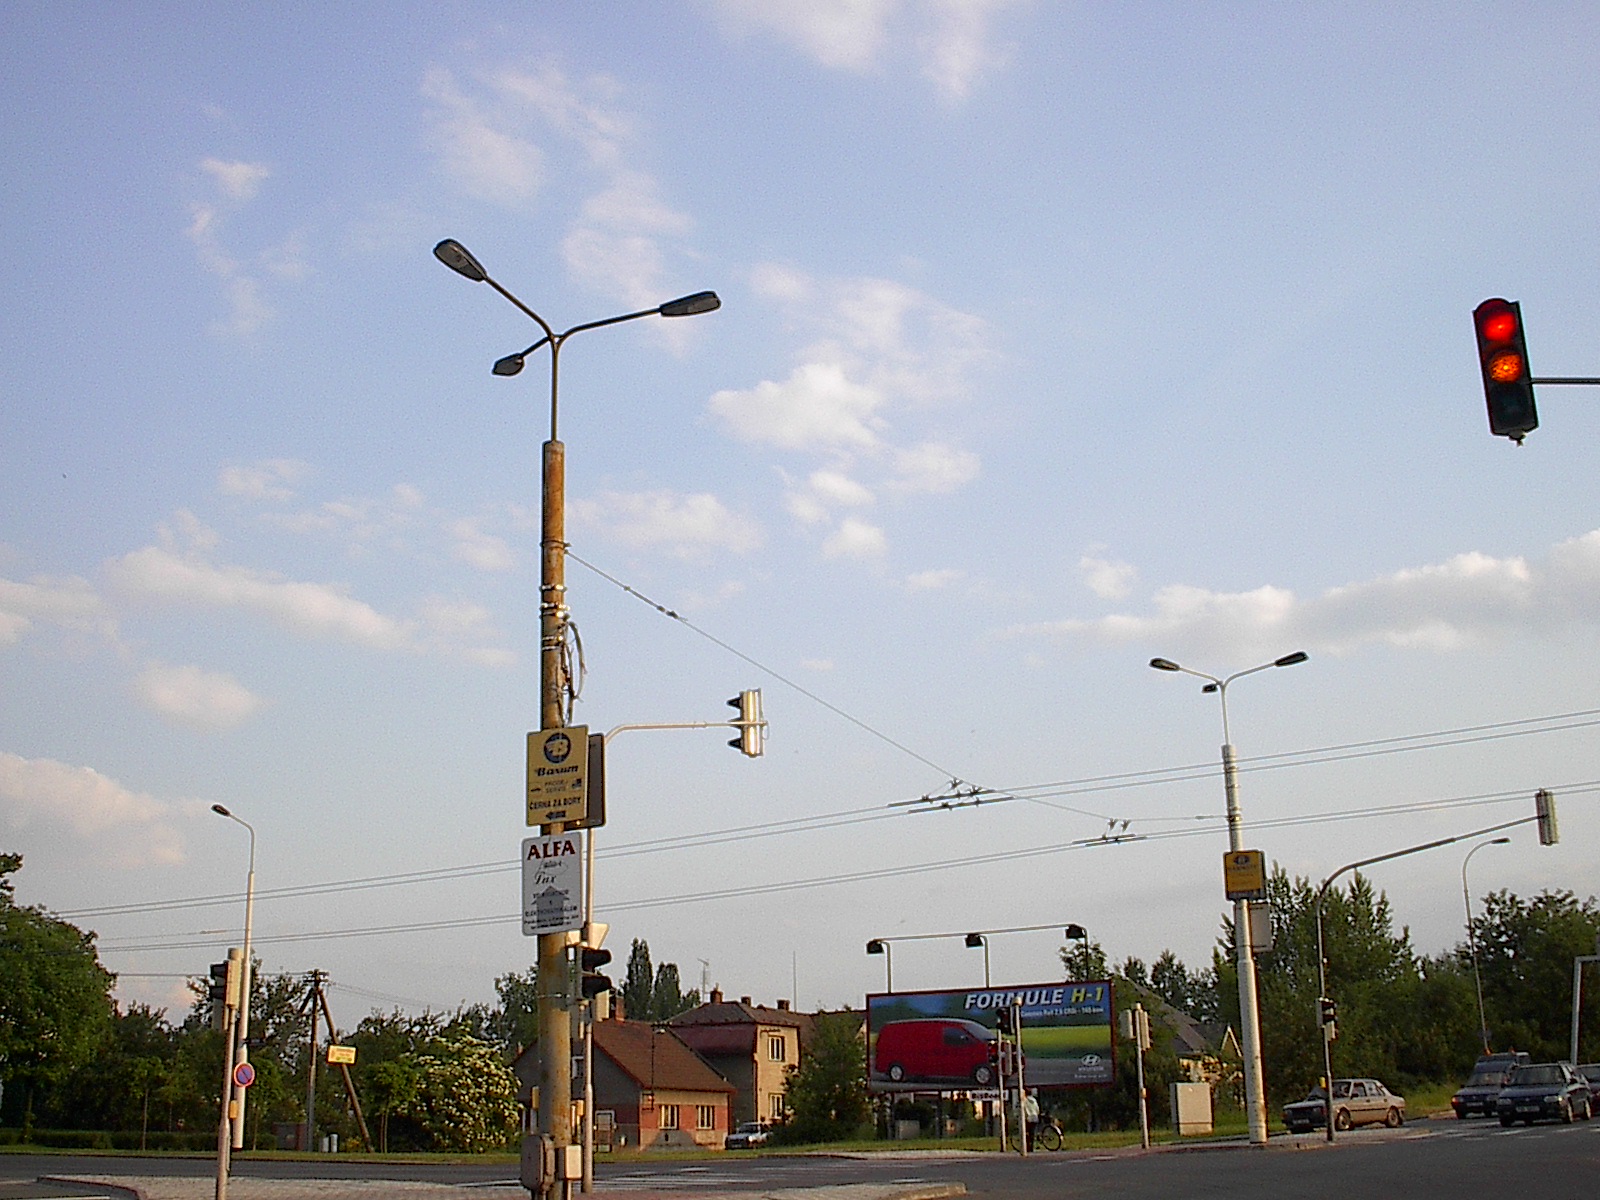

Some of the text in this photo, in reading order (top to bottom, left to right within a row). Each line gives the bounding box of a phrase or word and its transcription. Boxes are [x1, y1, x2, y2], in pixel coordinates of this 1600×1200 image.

[536, 765, 579, 777] Barum
[527, 840, 576, 860] ALFA
[965, 987, 1104, 1009] FORMULE H-1
